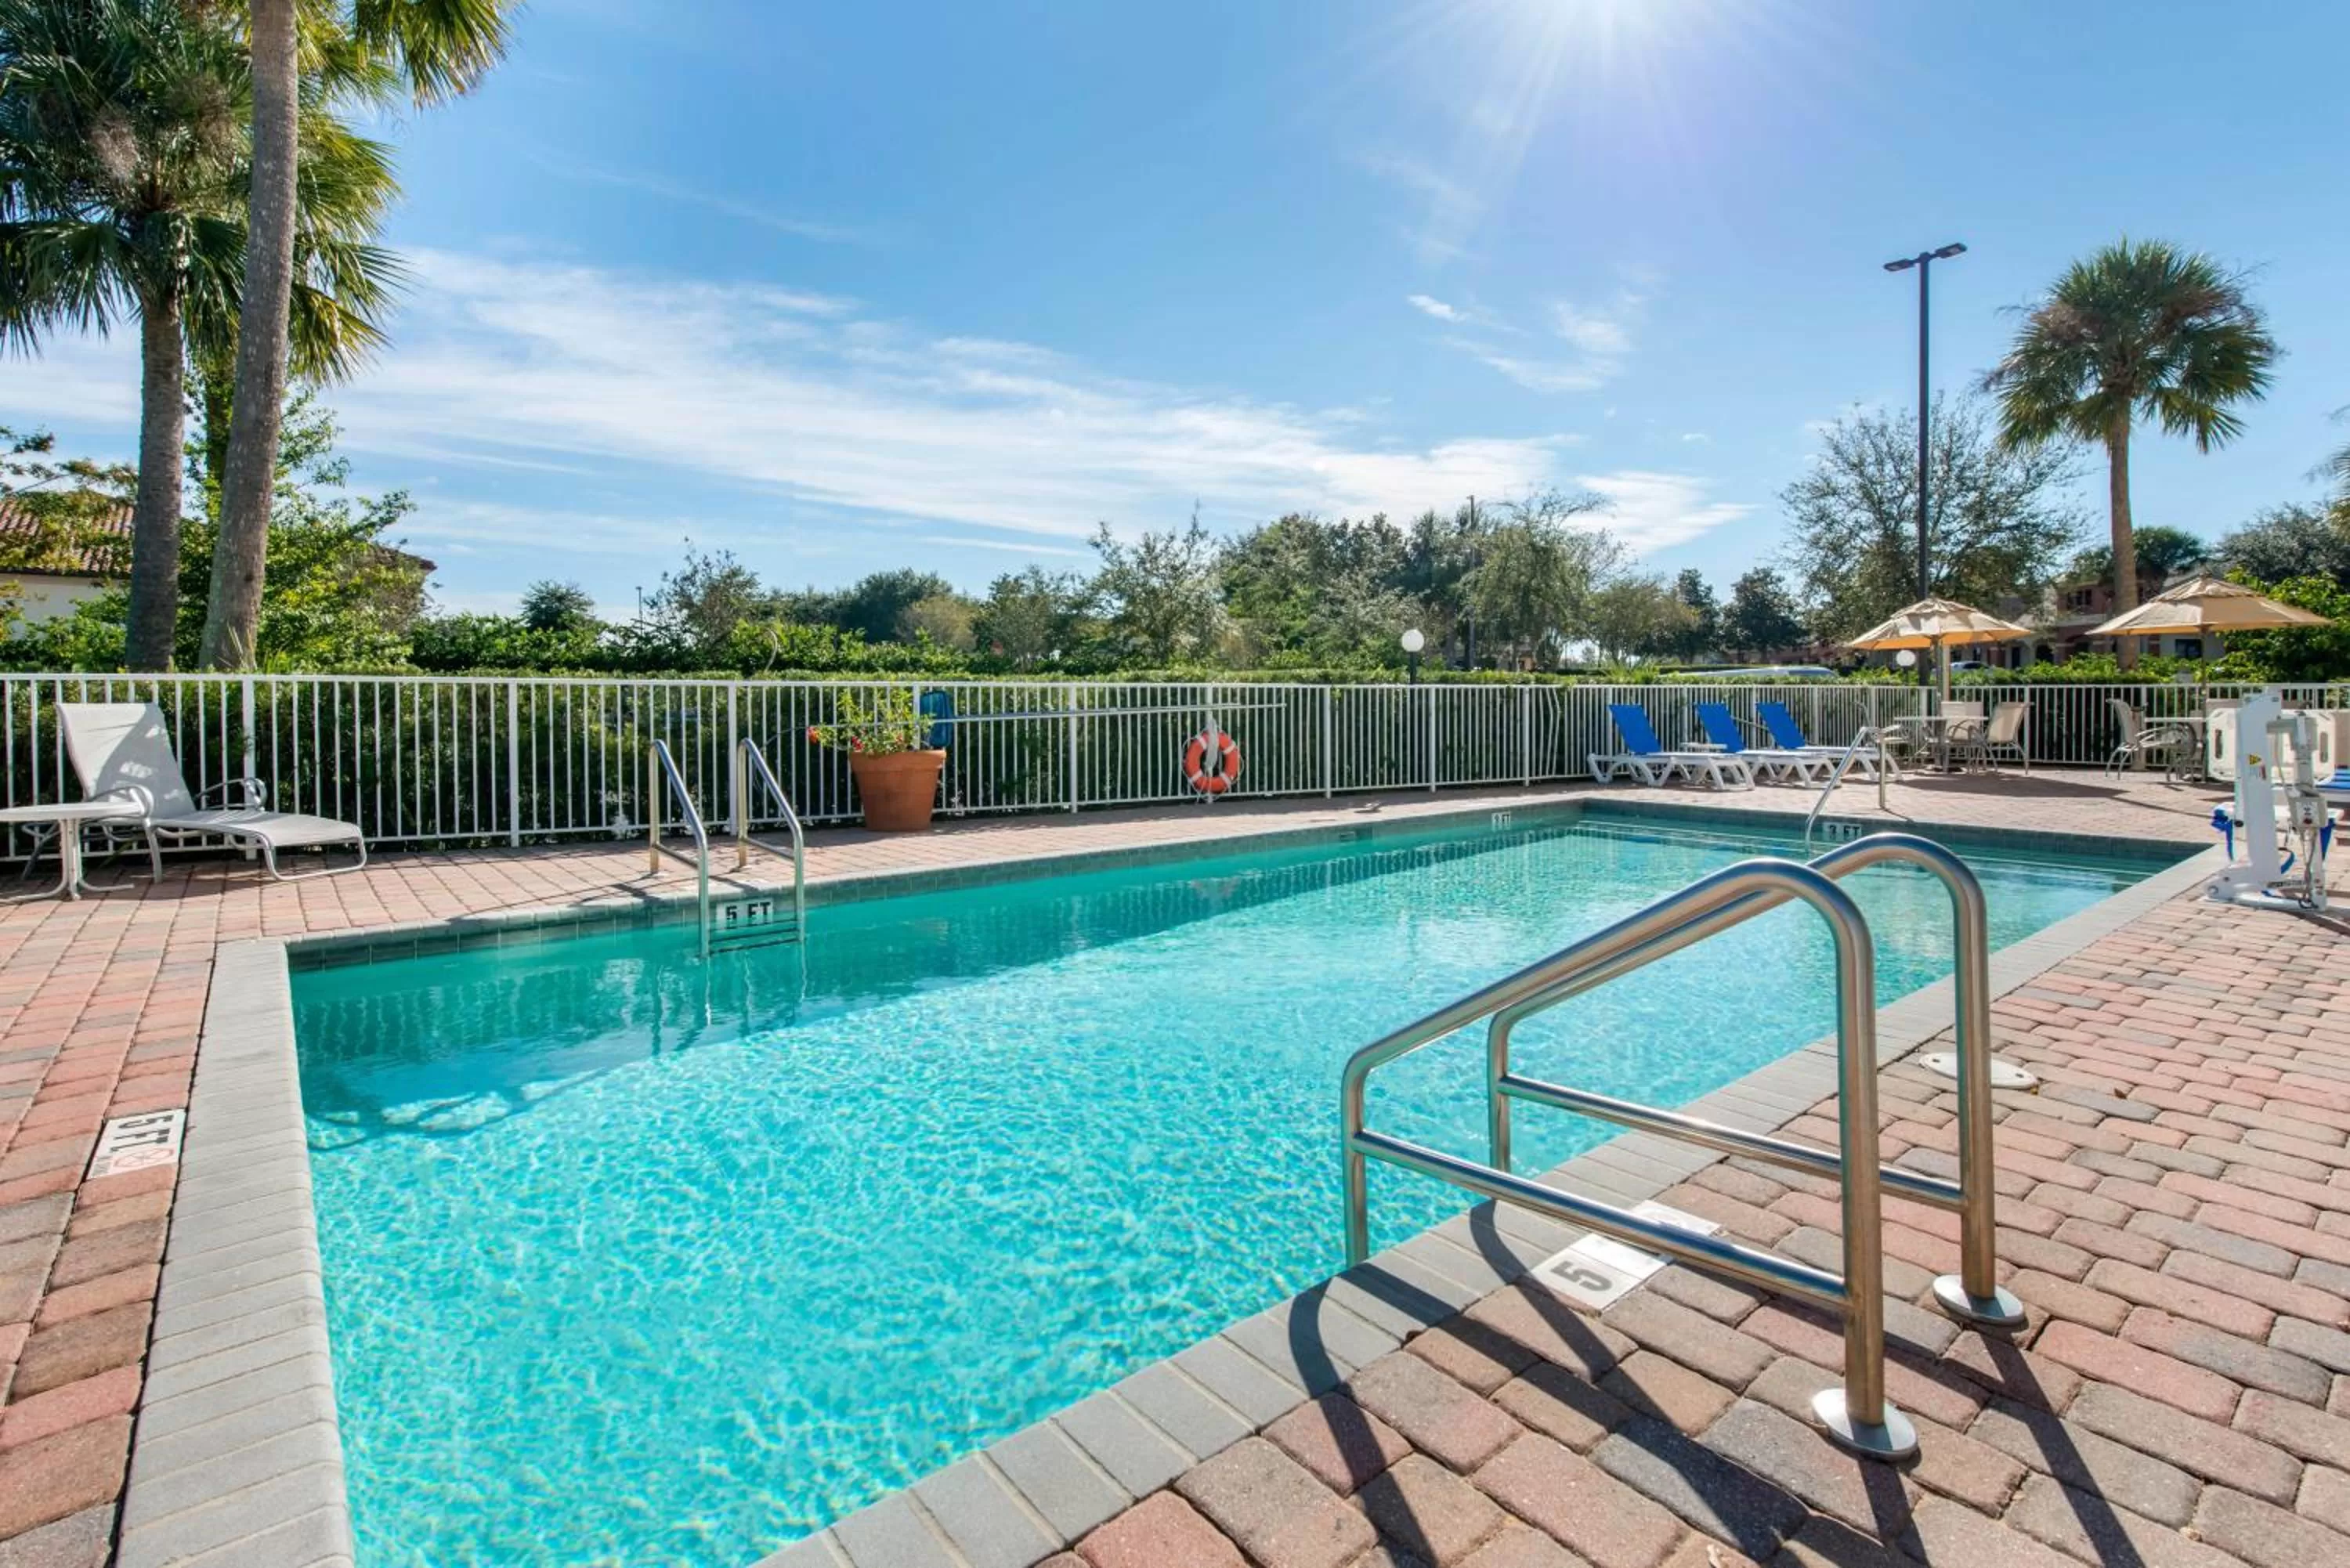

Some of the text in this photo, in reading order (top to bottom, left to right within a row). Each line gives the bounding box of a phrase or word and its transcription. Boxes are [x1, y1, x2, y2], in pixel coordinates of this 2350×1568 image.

[1843, 826, 1860, 839] FT
[748, 902, 771, 918] FT
[110, 1115, 174, 1152] 5 FT
[1550, 1259, 1614, 1292] 5
